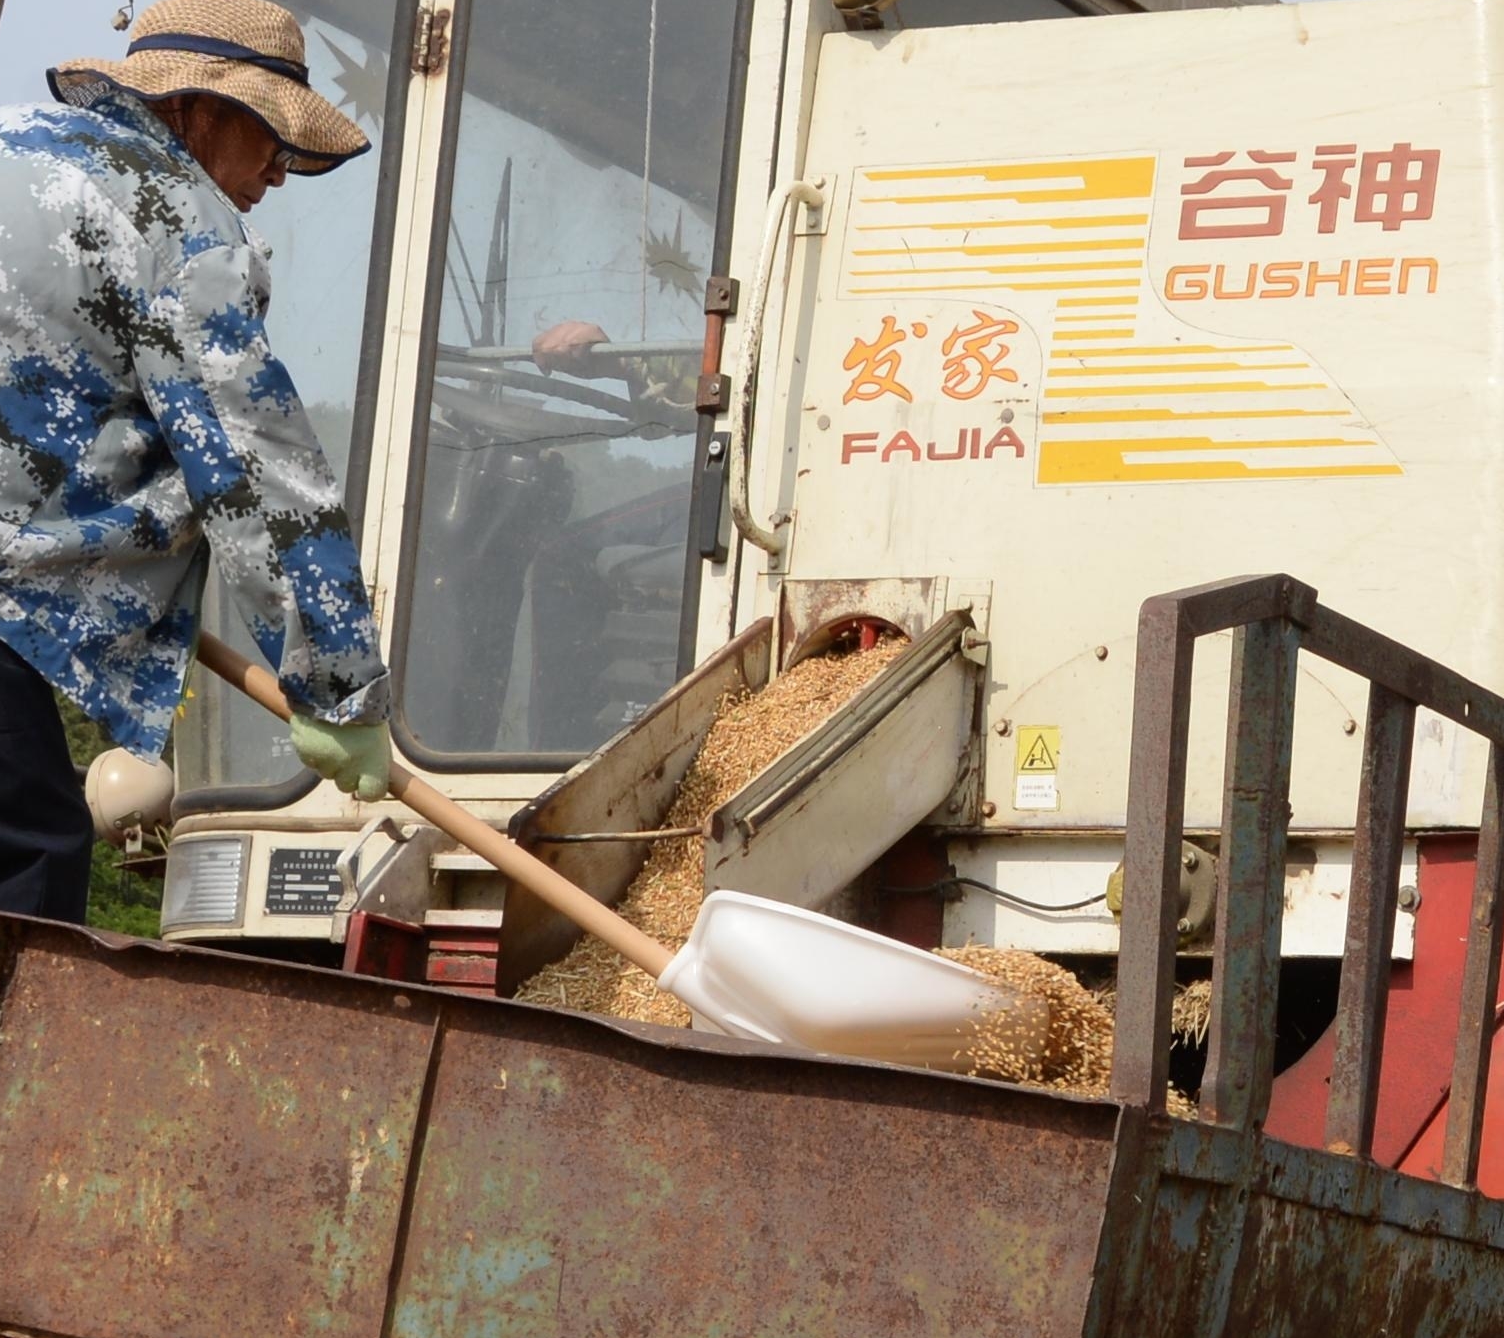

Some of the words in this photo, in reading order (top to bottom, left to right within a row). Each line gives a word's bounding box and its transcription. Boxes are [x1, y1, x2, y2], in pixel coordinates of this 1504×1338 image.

[1177, 142, 1441, 241] 谷神
[1164, 257, 1439, 301] GUSHEN
[842, 310, 1020, 405] 发家
[841, 427, 1026, 465] FAJIA
